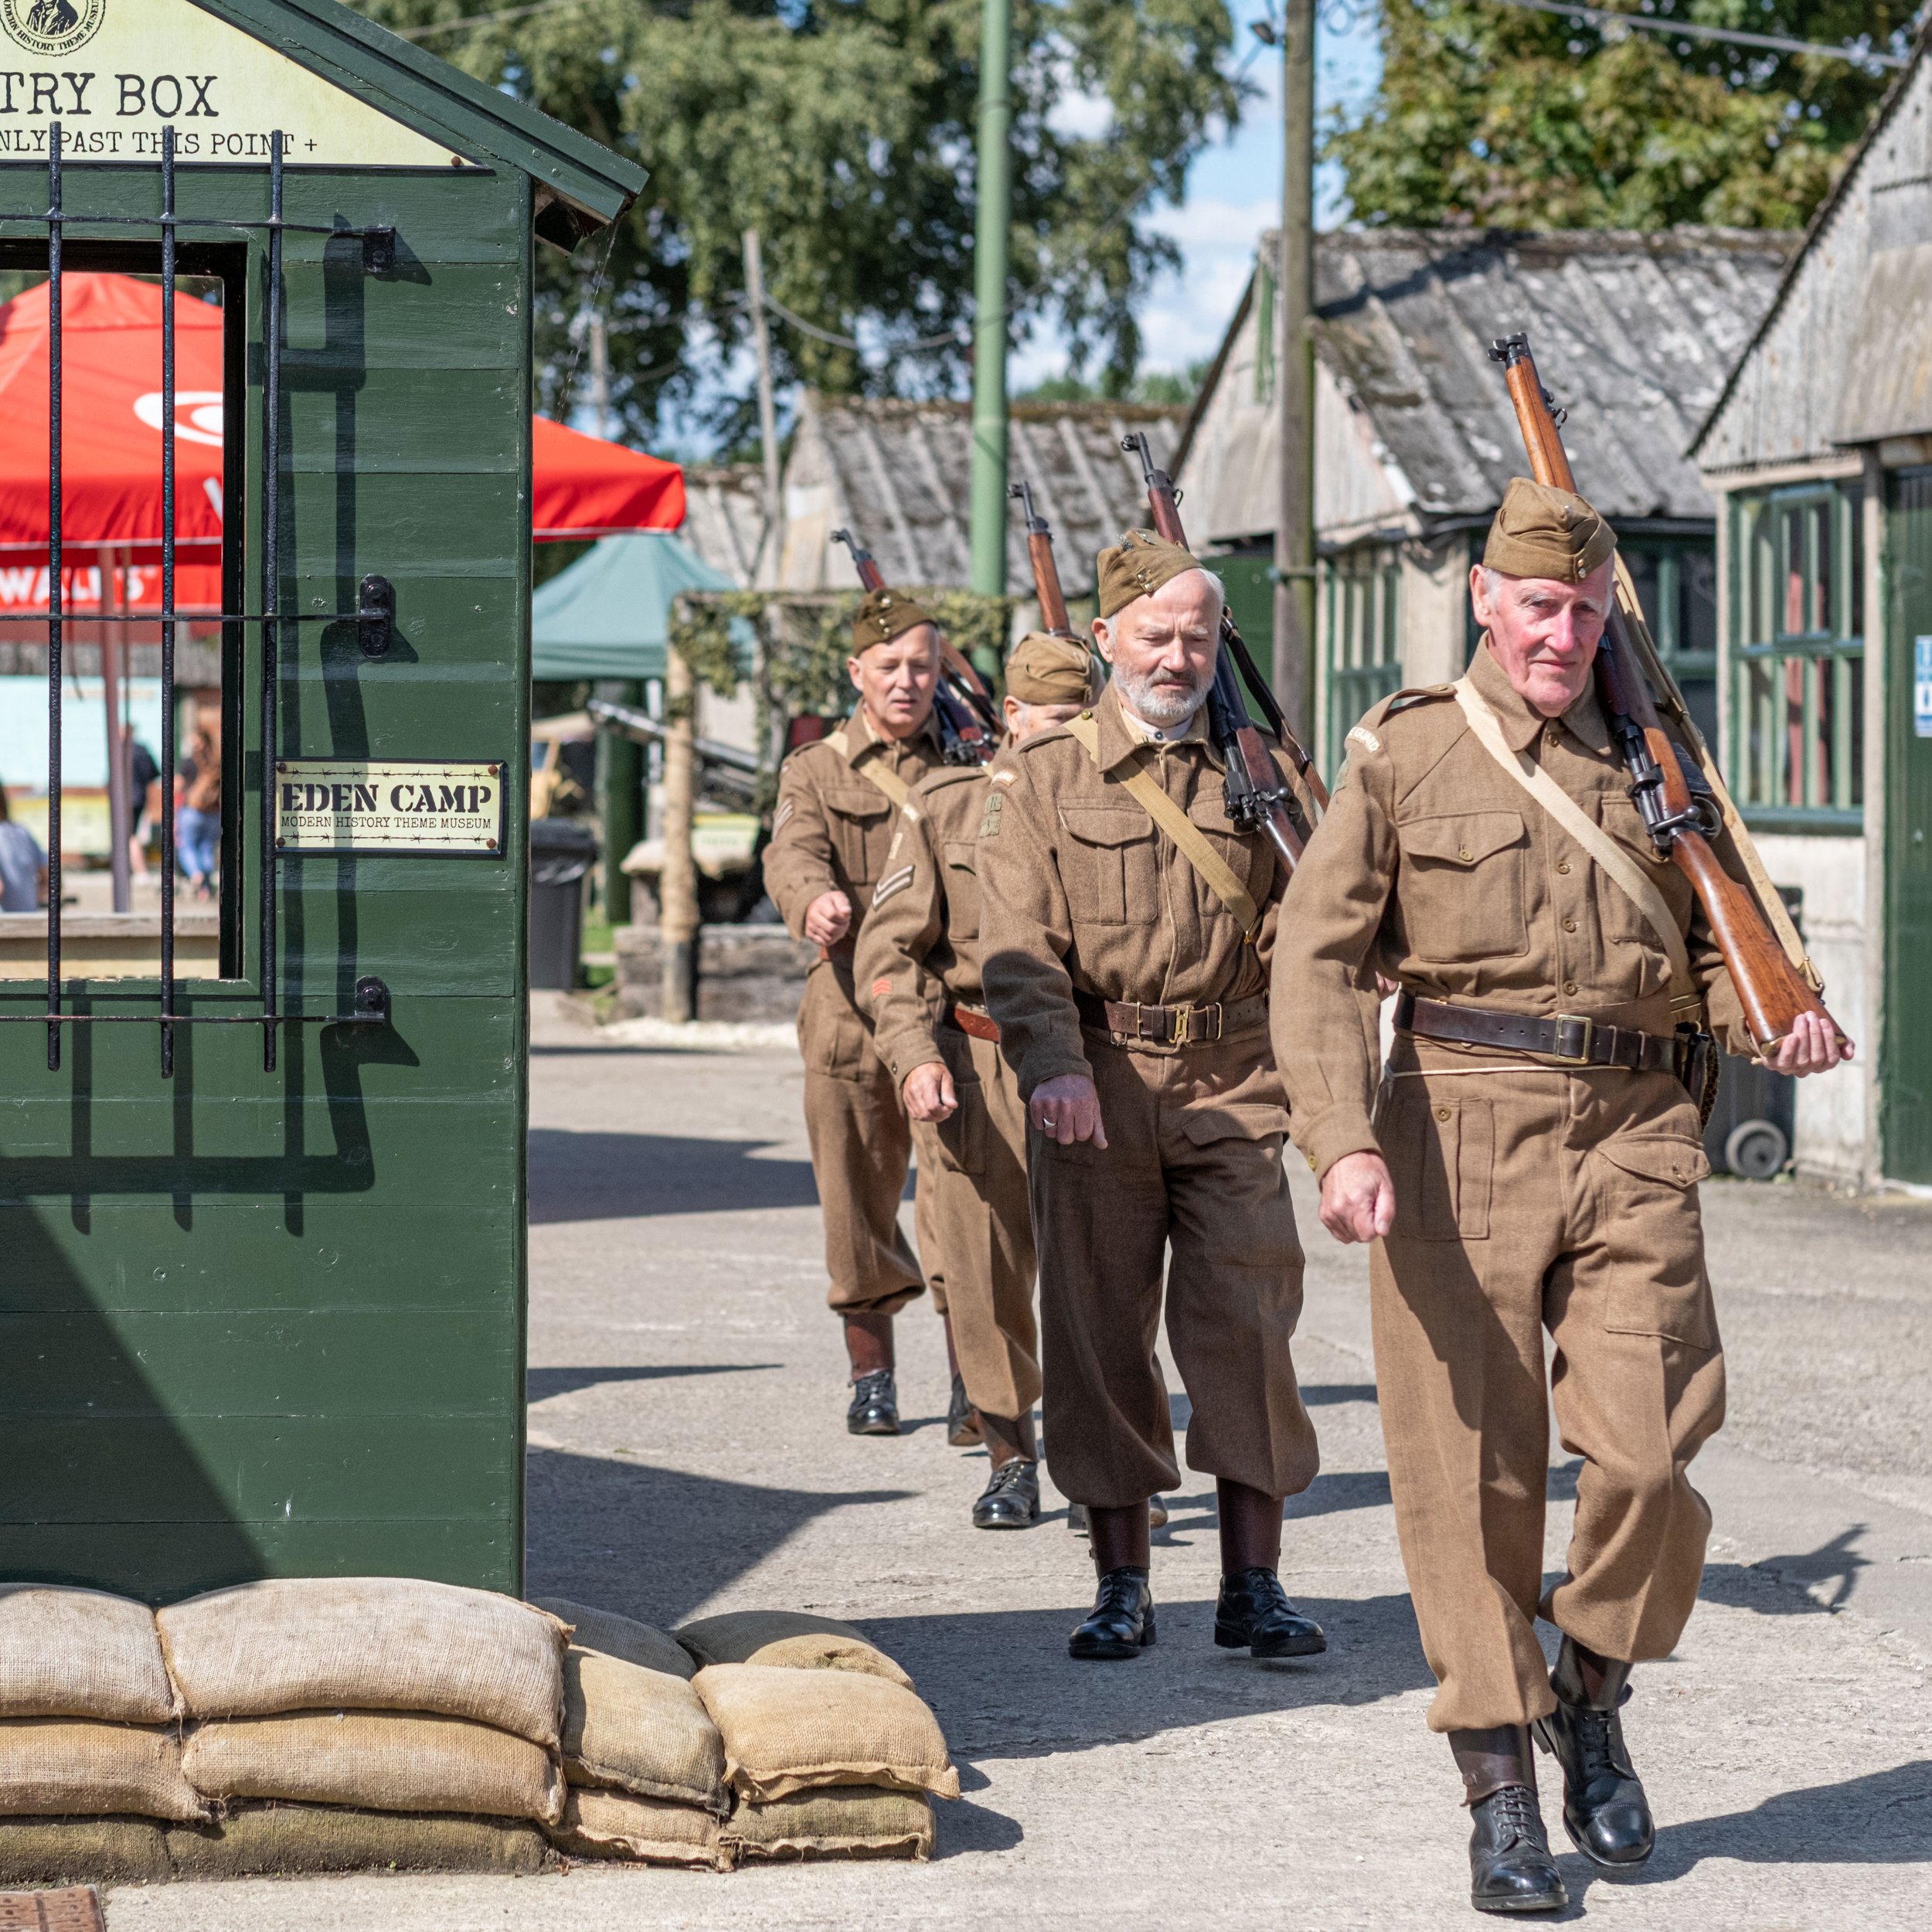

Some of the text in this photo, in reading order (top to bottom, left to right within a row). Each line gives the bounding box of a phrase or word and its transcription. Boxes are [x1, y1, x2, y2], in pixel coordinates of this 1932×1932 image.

[16, 30, 56, 51] HISTORY
[56, 29, 87, 50] THEME
[83, 0, 100, 32] MUSEU
[0, 72, 219, 117] TRY BOX
[60, 131, 122, 152] PAST
[132, 131, 200, 154] THIS
[210, 133, 294, 155] POINT
[281, 783, 492, 813] EDEN CAMP
[281, 816, 492, 829] MODERN HISTORY THEME MUSEUM
